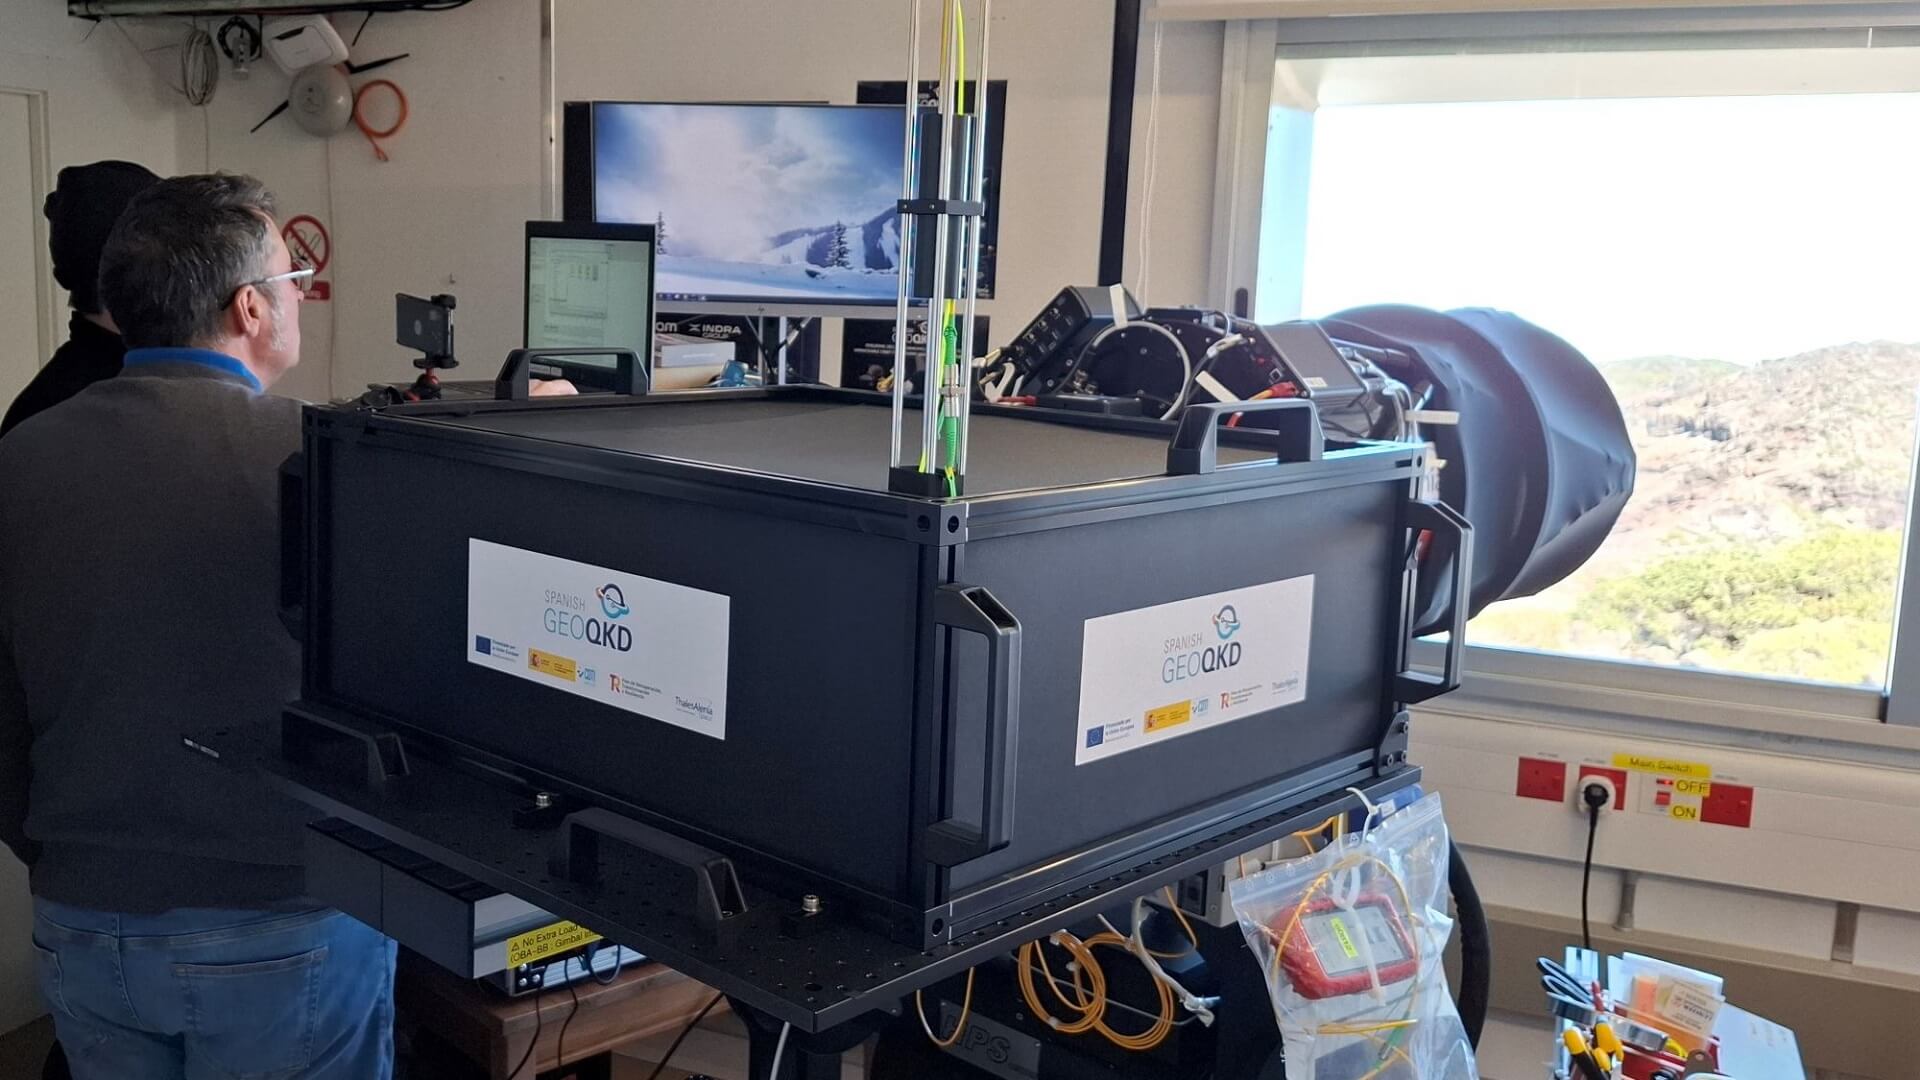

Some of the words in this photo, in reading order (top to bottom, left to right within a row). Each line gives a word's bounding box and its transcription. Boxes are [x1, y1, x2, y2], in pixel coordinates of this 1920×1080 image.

[702, 324, 742, 335] INDRA
[544, 589, 586, 612] SPANISH
[543, 607, 632, 652] GEOQKD
[1164, 632, 1203, 654] SPANISH
[1162, 642, 1242, 684] GEOQKD
[1630, 757, 1655, 769] Main
[1659, 761, 1692, 773] Switch
[1676, 779, 1708, 793] OFF
[1672, 805, 1696, 818] ON
[522, 938, 534, 948] No
[537, 930, 557, 942] Extra
[559, 924, 578, 935] Load
[555, 931, 582, 947] Gimbal
